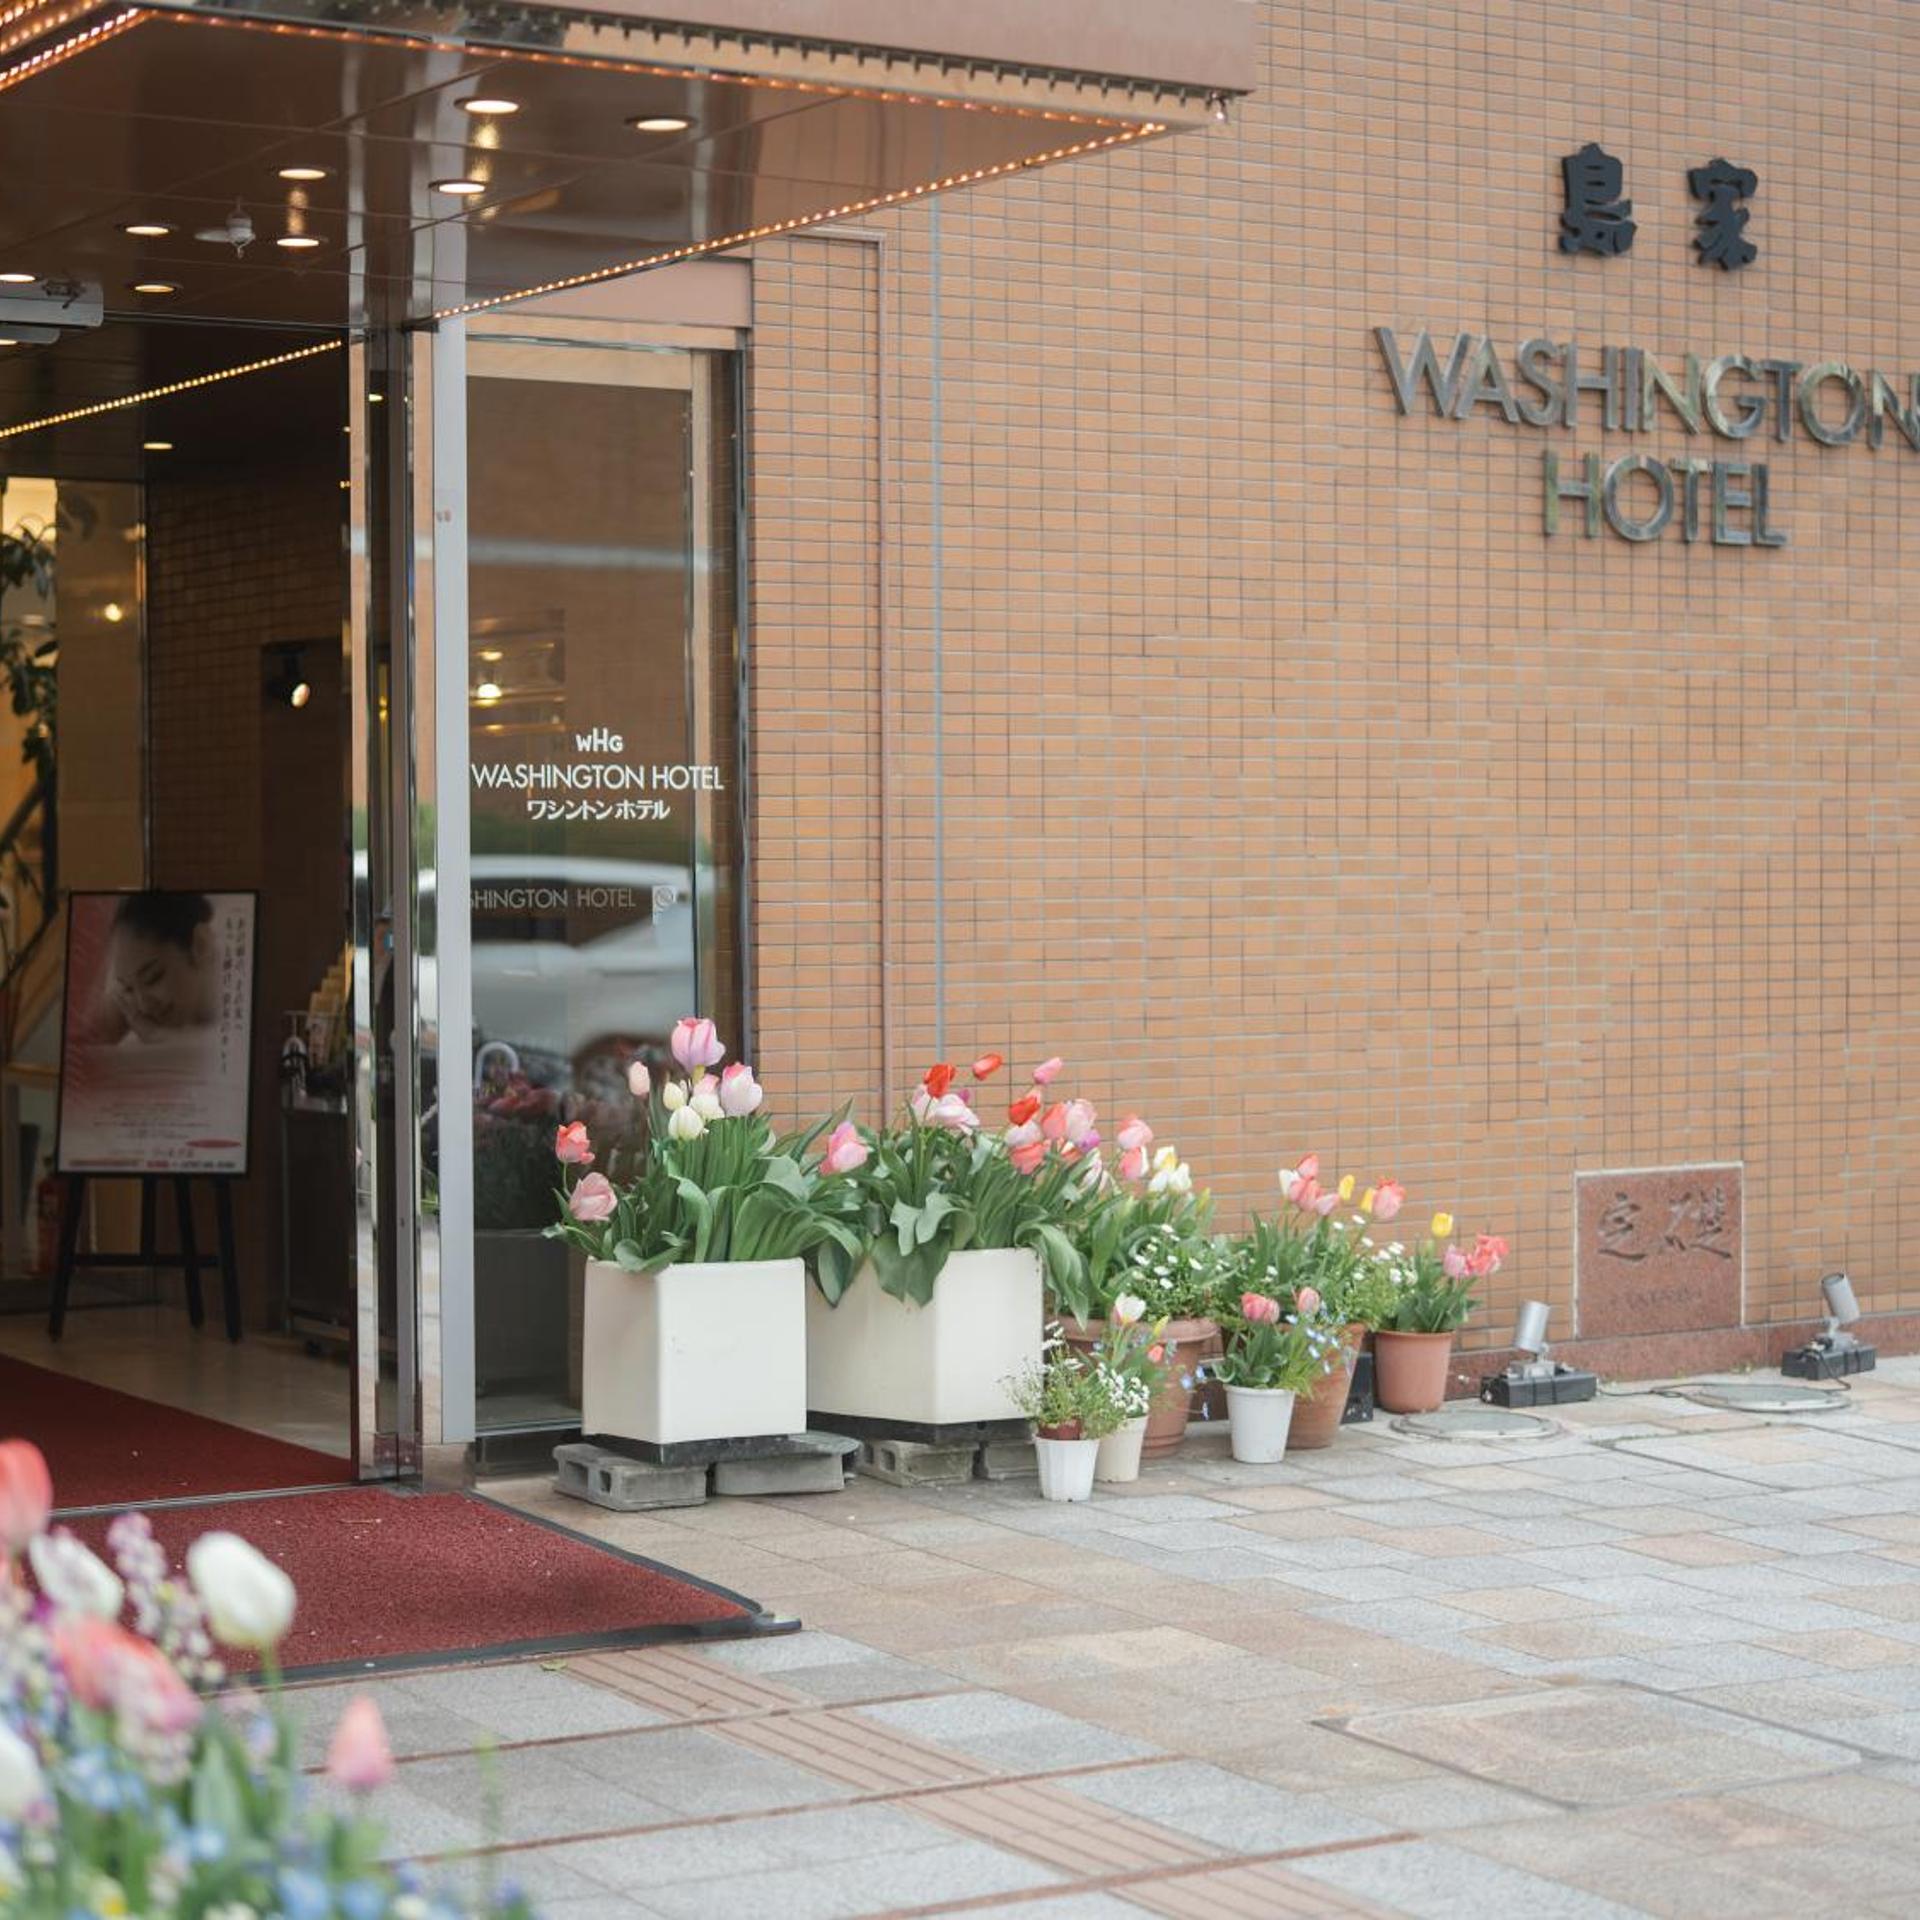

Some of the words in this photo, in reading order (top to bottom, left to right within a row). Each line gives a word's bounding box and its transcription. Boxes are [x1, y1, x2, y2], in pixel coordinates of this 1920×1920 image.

[1374, 326, 1920, 452] WASHINGTON
[1543, 448, 1787, 547] HOTEL
[471, 764, 645, 790] WASHINGTON
[652, 765, 724, 790] HOTEL
[527, 800, 671, 820] ワシントンホテル
[470, 888, 569, 910] HINGTON
[576, 887, 636, 908] HOTEL
